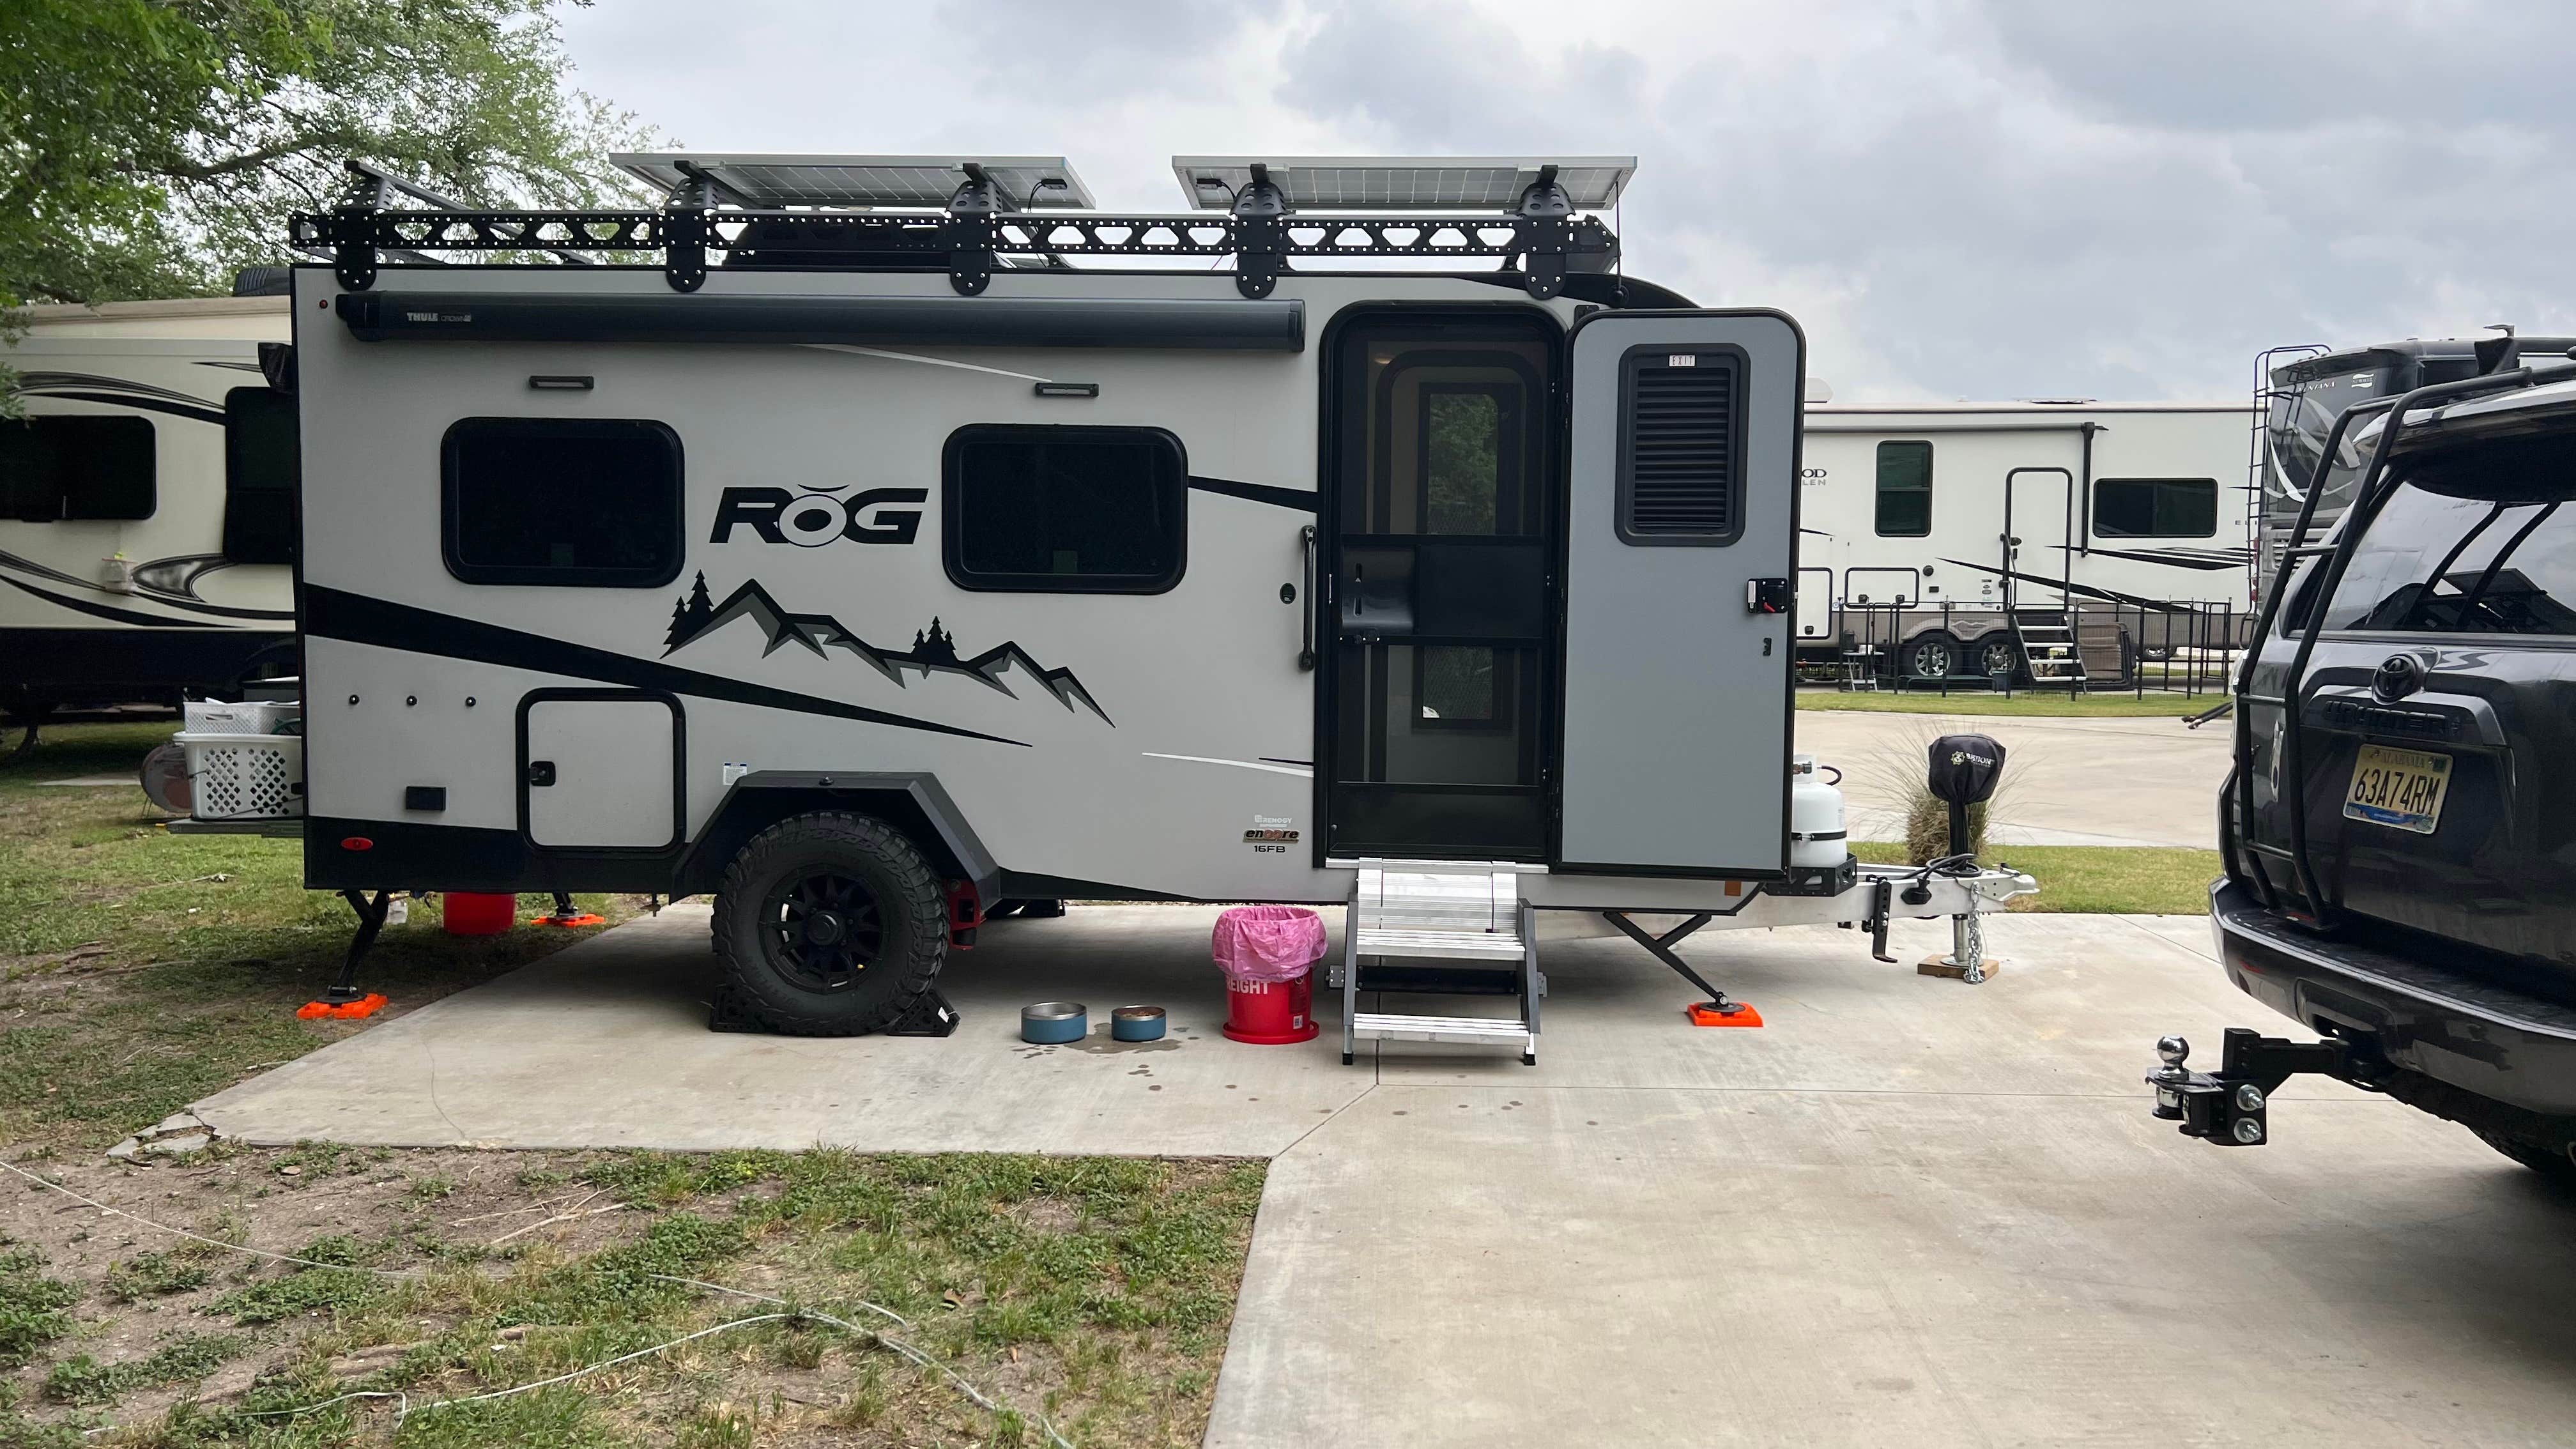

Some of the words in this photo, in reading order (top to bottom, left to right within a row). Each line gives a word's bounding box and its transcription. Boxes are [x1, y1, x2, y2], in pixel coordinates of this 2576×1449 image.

[406, 312, 438, 321] THULE
[1672, 356, 1692, 365] EXIT
[709, 486, 929, 548] ROG
[2354, 768, 2441, 815] 63A74RM
